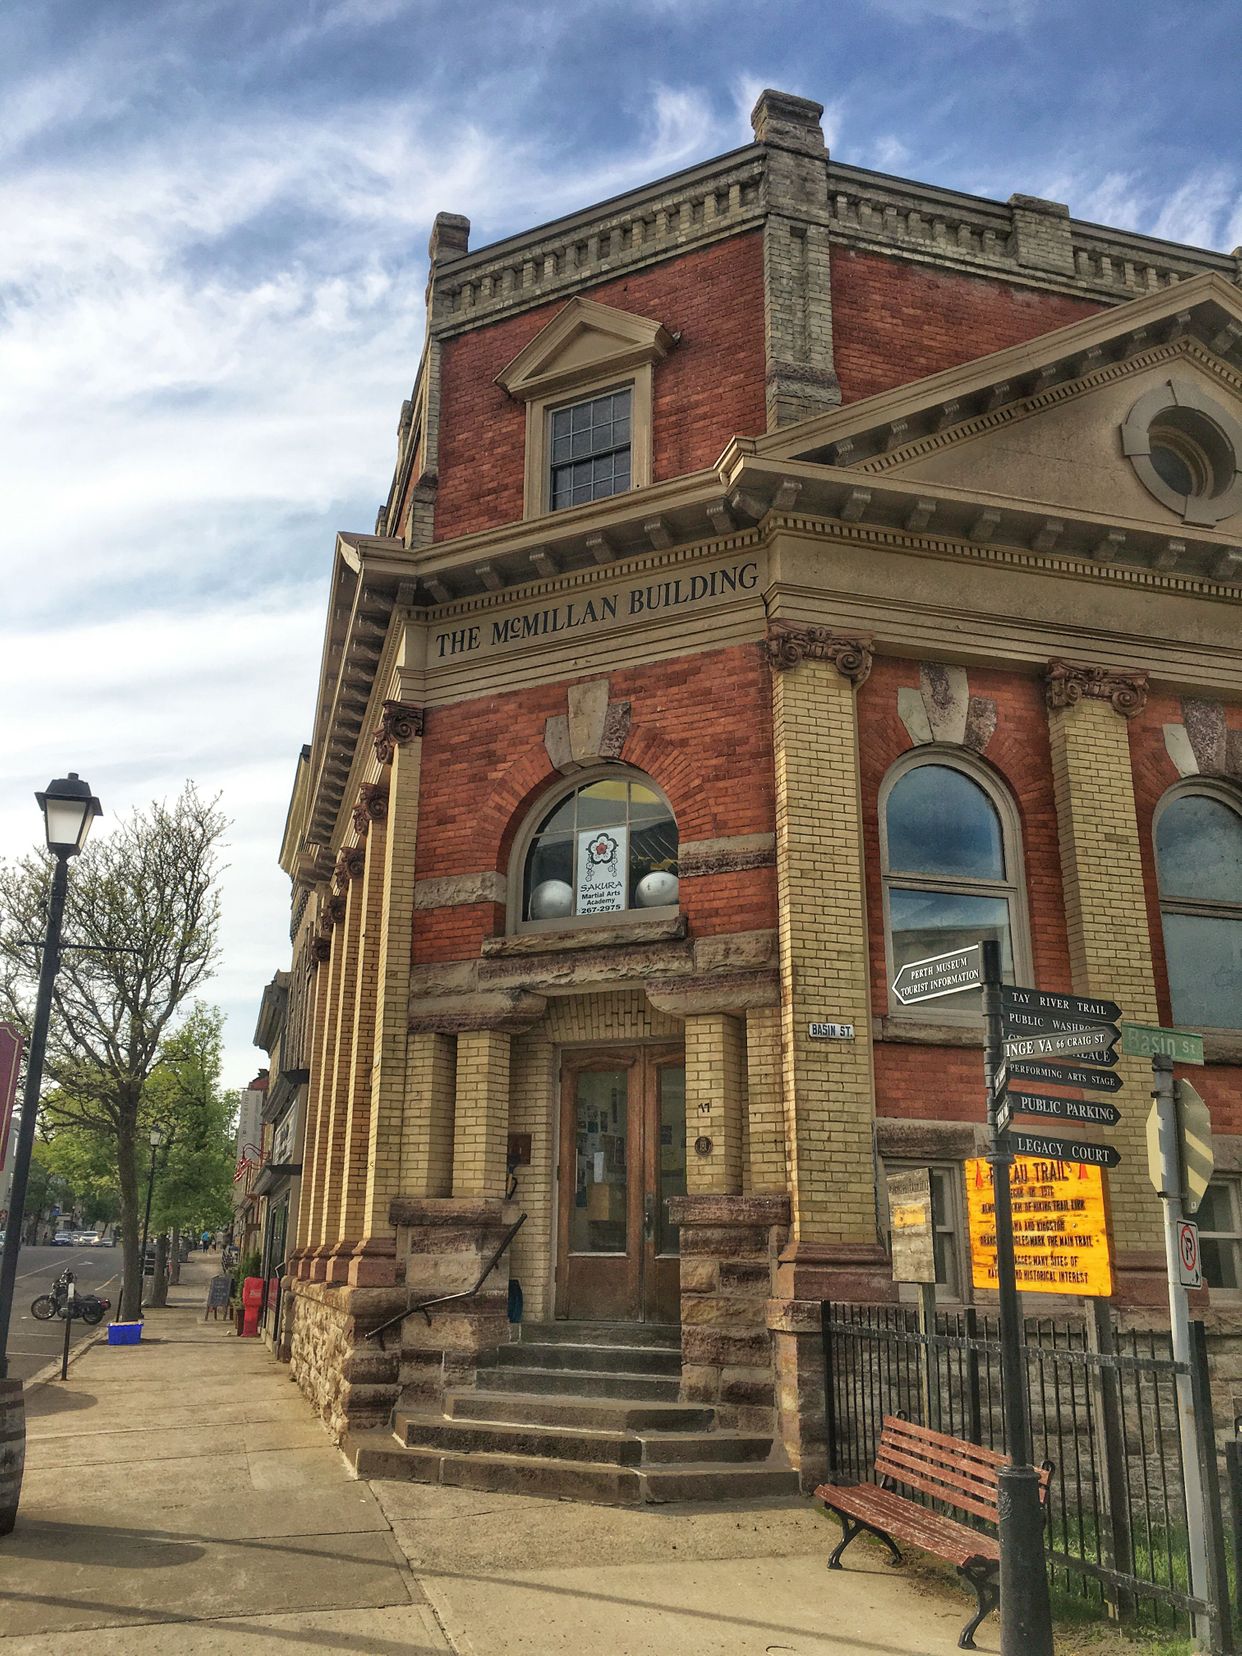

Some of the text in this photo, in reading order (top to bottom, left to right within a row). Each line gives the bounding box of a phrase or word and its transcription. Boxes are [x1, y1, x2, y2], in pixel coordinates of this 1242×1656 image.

[435, 625, 481, 658] THE
[628, 562, 759, 615] BUILDING
[580, 881, 622, 892] SAKURA
[581, 892, 605, 900] Martial
[581, 904, 621, 914] 267-2975
[911, 957, 967, 980] PERTH MUSEUM
[901, 969, 980, 997] TOURIST INFORMATION
[1012, 992, 1107, 1015] TAY RIVER TRAIL
[812, 1024, 836, 1036] BASIN
[1009, 1013, 1044, 1027] PUBLIC
[1006, 1034, 1104, 1057] INGE VA 66 CRAIG ST
[1128, 1027, 1196, 1057] Basin St
[1009, 1063, 1062, 1079] PERFORMING
[1067, 1072, 1087, 1083] ARTS
[1091, 1075, 1115, 1087] STAGE
[1021, 1096, 1114, 1120] PUBLIC PARKING
[1018, 1137, 1110, 1162] LEGACY COURT
[1050, 1255, 1069, 1267] SITES
[1023, 1269, 1056, 1281] HISTORICAL
[1058, 1271, 1089, 1283] INTEREST
